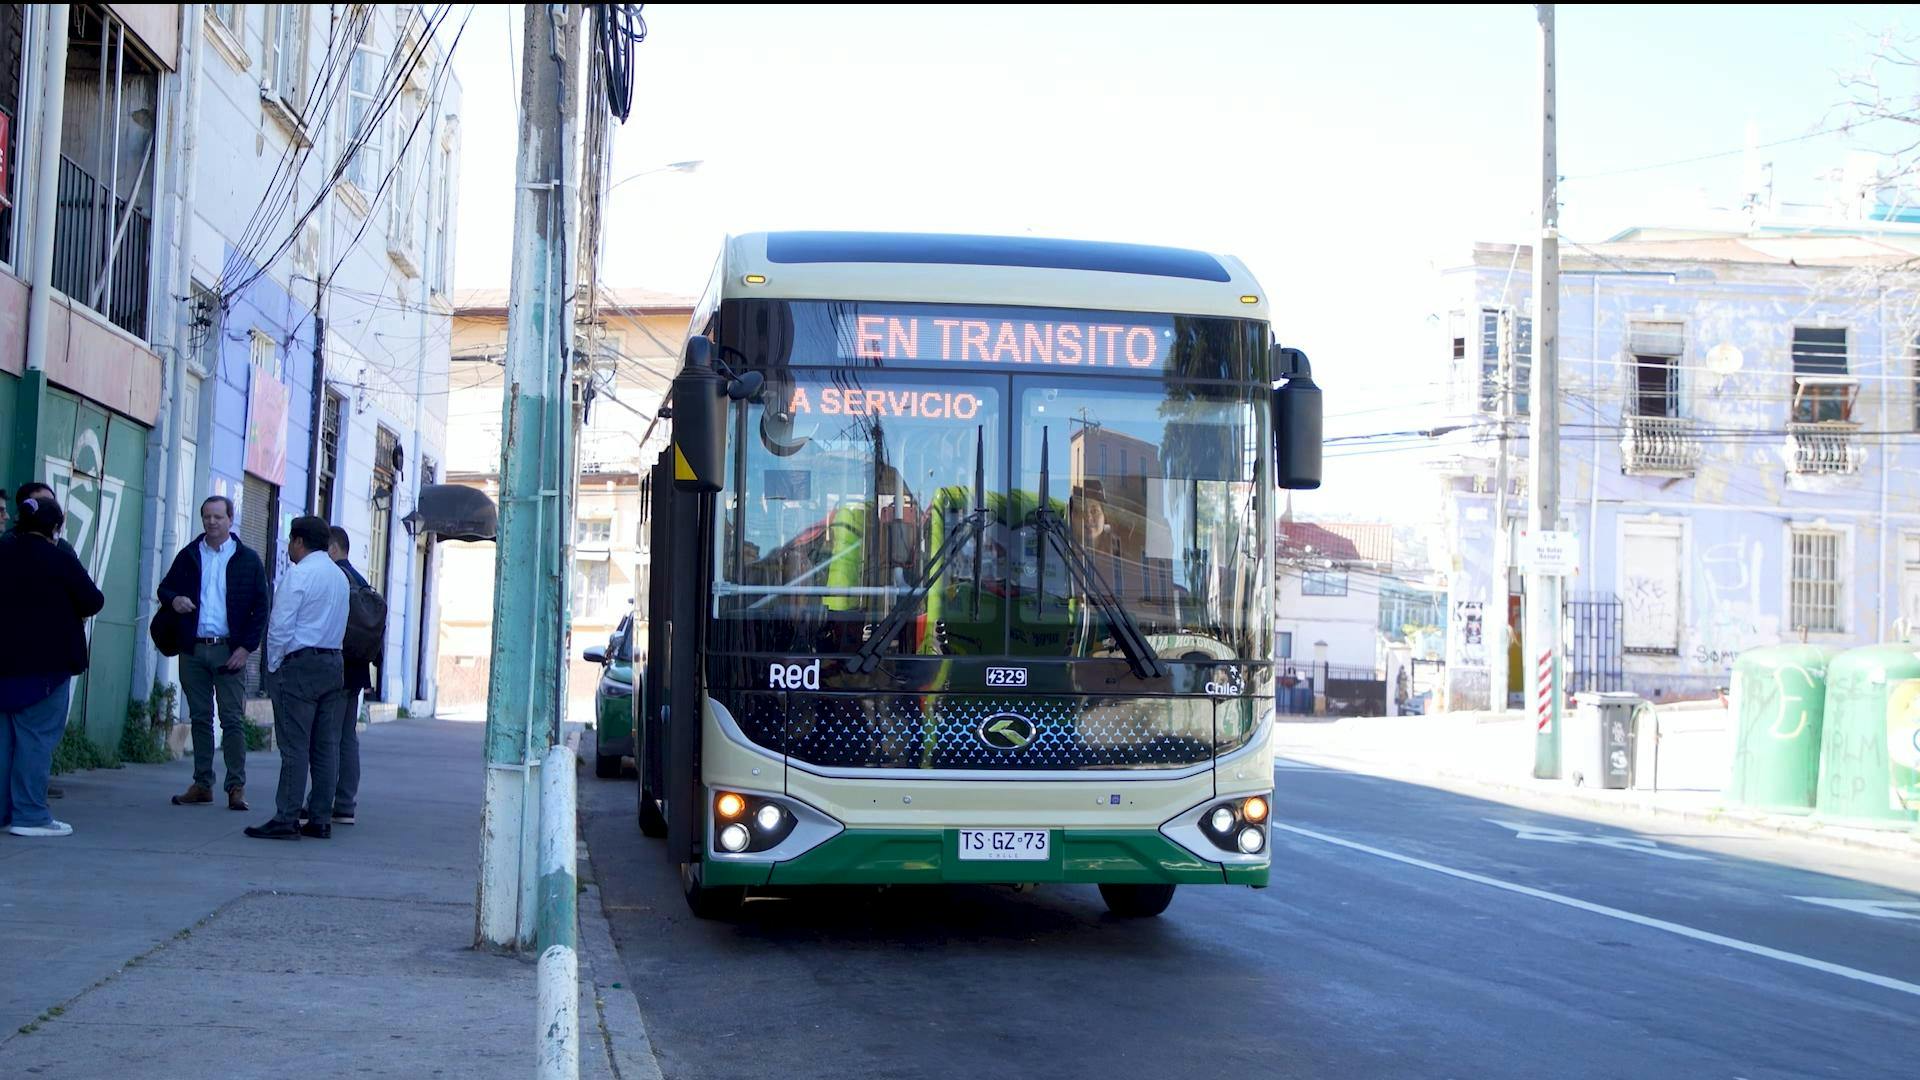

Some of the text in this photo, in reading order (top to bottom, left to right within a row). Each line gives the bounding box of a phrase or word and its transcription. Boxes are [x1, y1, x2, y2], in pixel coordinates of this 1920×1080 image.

[857, 316, 1157, 366] EN TRANSITO
[789, 387, 978, 419] A SERVICIO
[769, 658, 820, 690] Red
[995, 670, 1025, 684] 329
[1205, 682, 1238, 694] Chile
